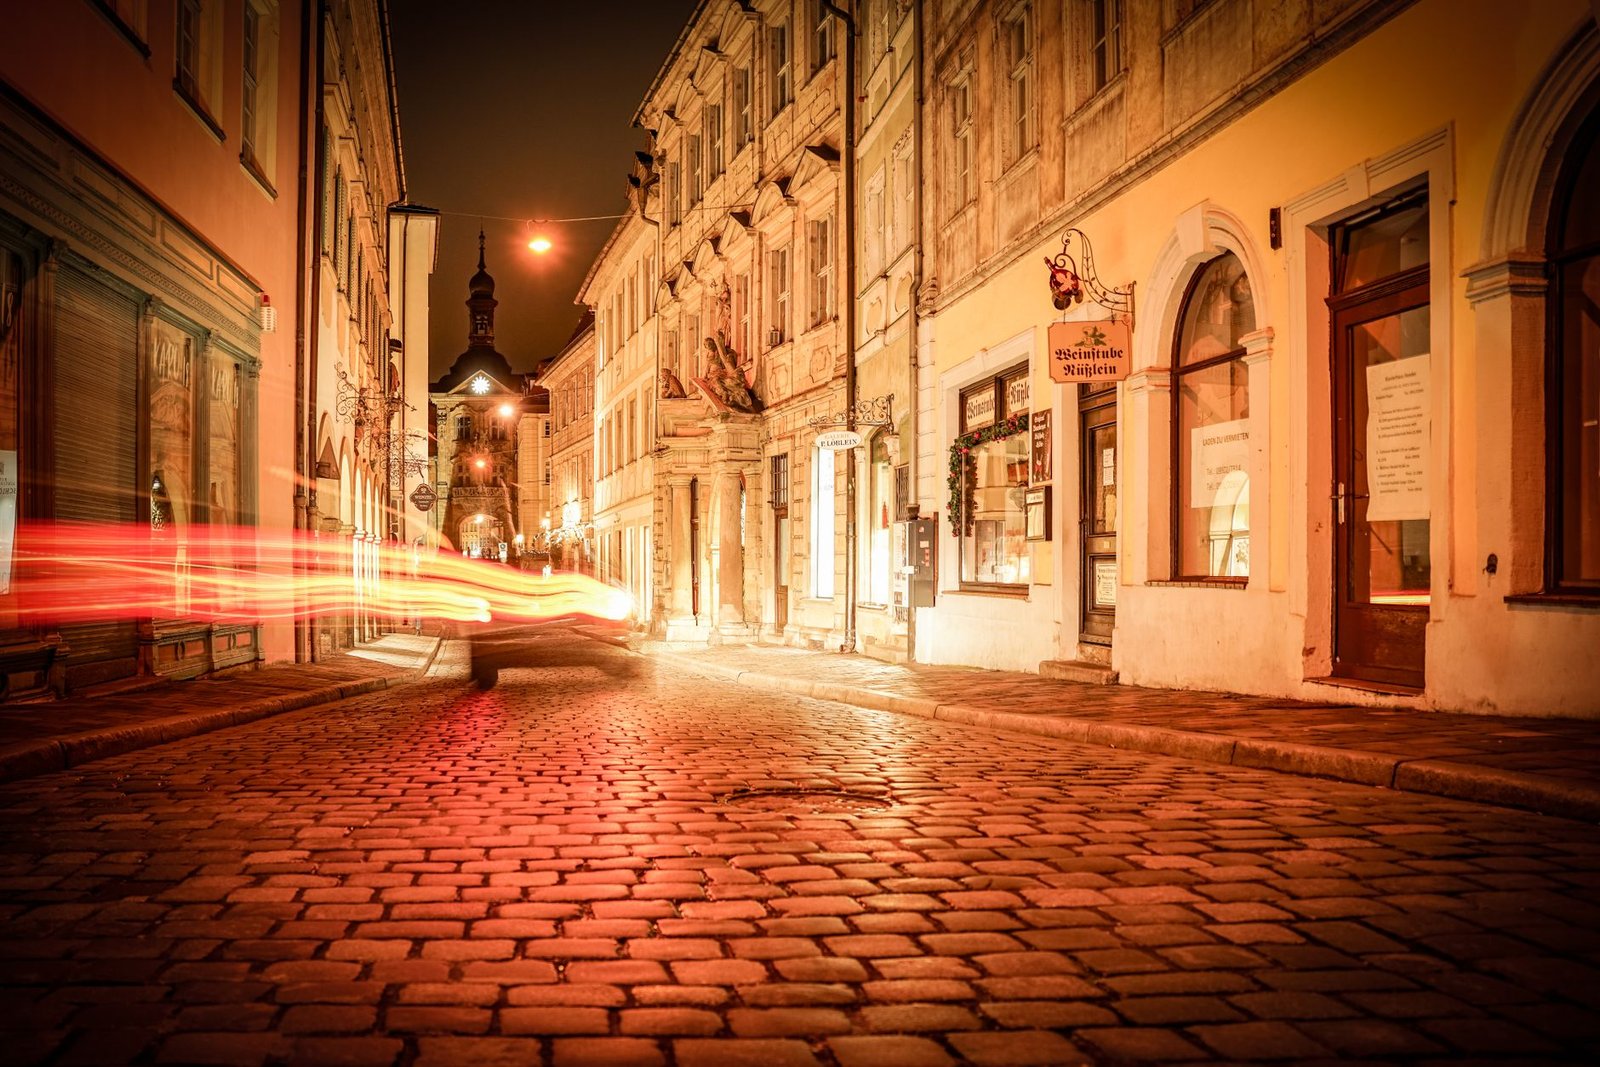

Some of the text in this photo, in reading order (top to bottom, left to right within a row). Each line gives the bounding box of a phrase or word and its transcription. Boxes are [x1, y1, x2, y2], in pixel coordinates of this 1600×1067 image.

[1063, 363, 1116, 378] Nüßlein
[1203, 432, 1249, 446] LADEN ZU VERMIETEN
